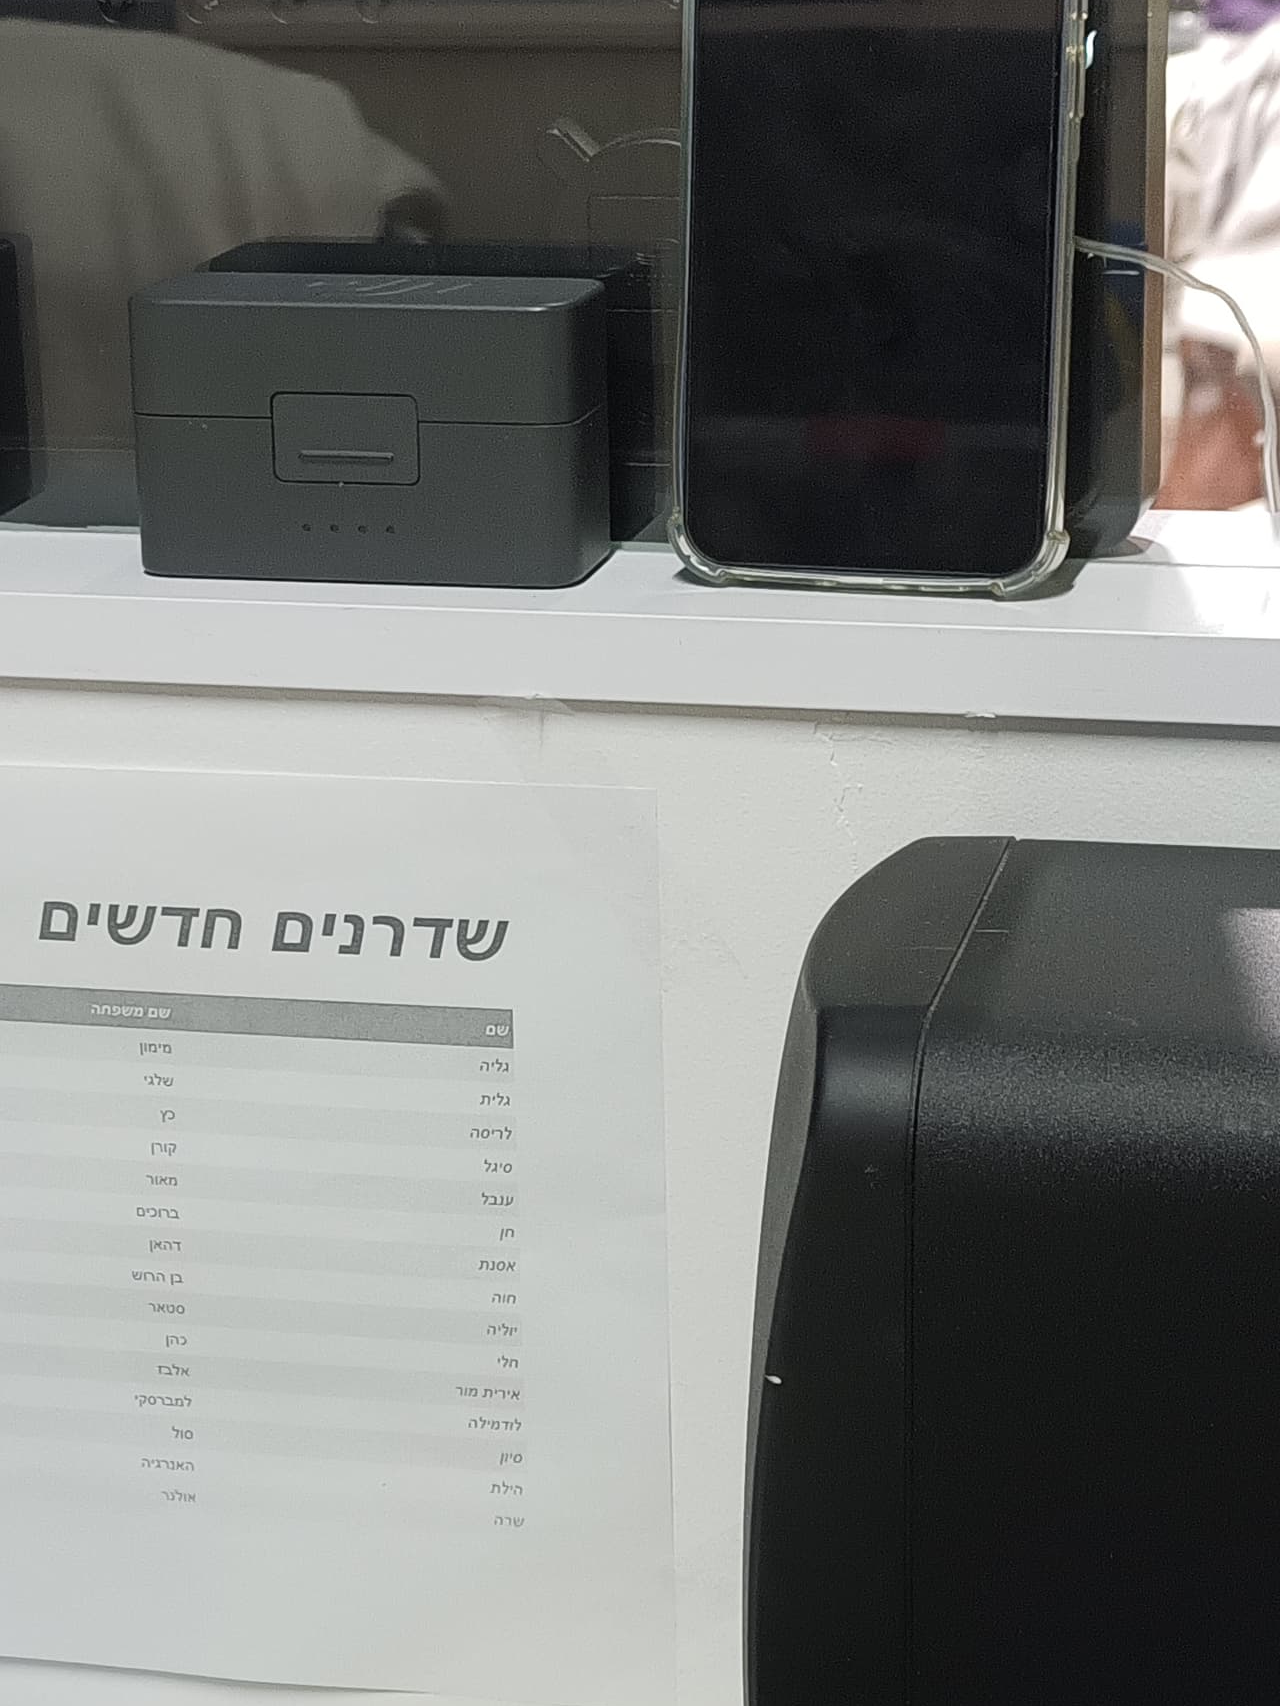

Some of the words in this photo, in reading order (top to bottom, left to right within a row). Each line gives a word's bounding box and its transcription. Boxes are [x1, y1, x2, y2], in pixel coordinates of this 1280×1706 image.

[38, 901, 242, 950] חדשים
[271, 911, 510, 961] שדרנים
[91, 1004, 143, 1017] משפחה
[147, 1008, 171, 1019] שם
[485, 1024, 509, 1037] שם
[139, 1042, 172, 1055] מימון
[479, 1059, 509, 1072] גליה
[143, 1074, 173, 1087] שלגי
[480, 1093, 510, 1106] גלית
[160, 1110, 175, 1122] כץ
[470, 1127, 512, 1140] לריסה
[151, 1142, 177, 1156] קורן
[483, 1160, 512, 1174] סיגל
[146, 1175, 178, 1186] מאור
[481, 1193, 513, 1206] ענבל
[499, 1227, 514, 1240] חן
[149, 1240, 181, 1252] דהאן
[478, 1260, 516, 1272] אסנת
[170, 1273, 184, 1284] בן
[491, 1293, 516, 1304] חוה
[487, 1324, 517, 1336] יוליה
[166, 1335, 187, 1347] כהן
[497, 1356, 519, 1368] חלי
[456, 1386, 478, 1397] מור
[483, 1387, 520, 1400] אירית
[468, 1417, 522, 1431] לודמילה
[171, 1426, 194, 1440] סול
[494, 1516, 524, 1527] שרה
